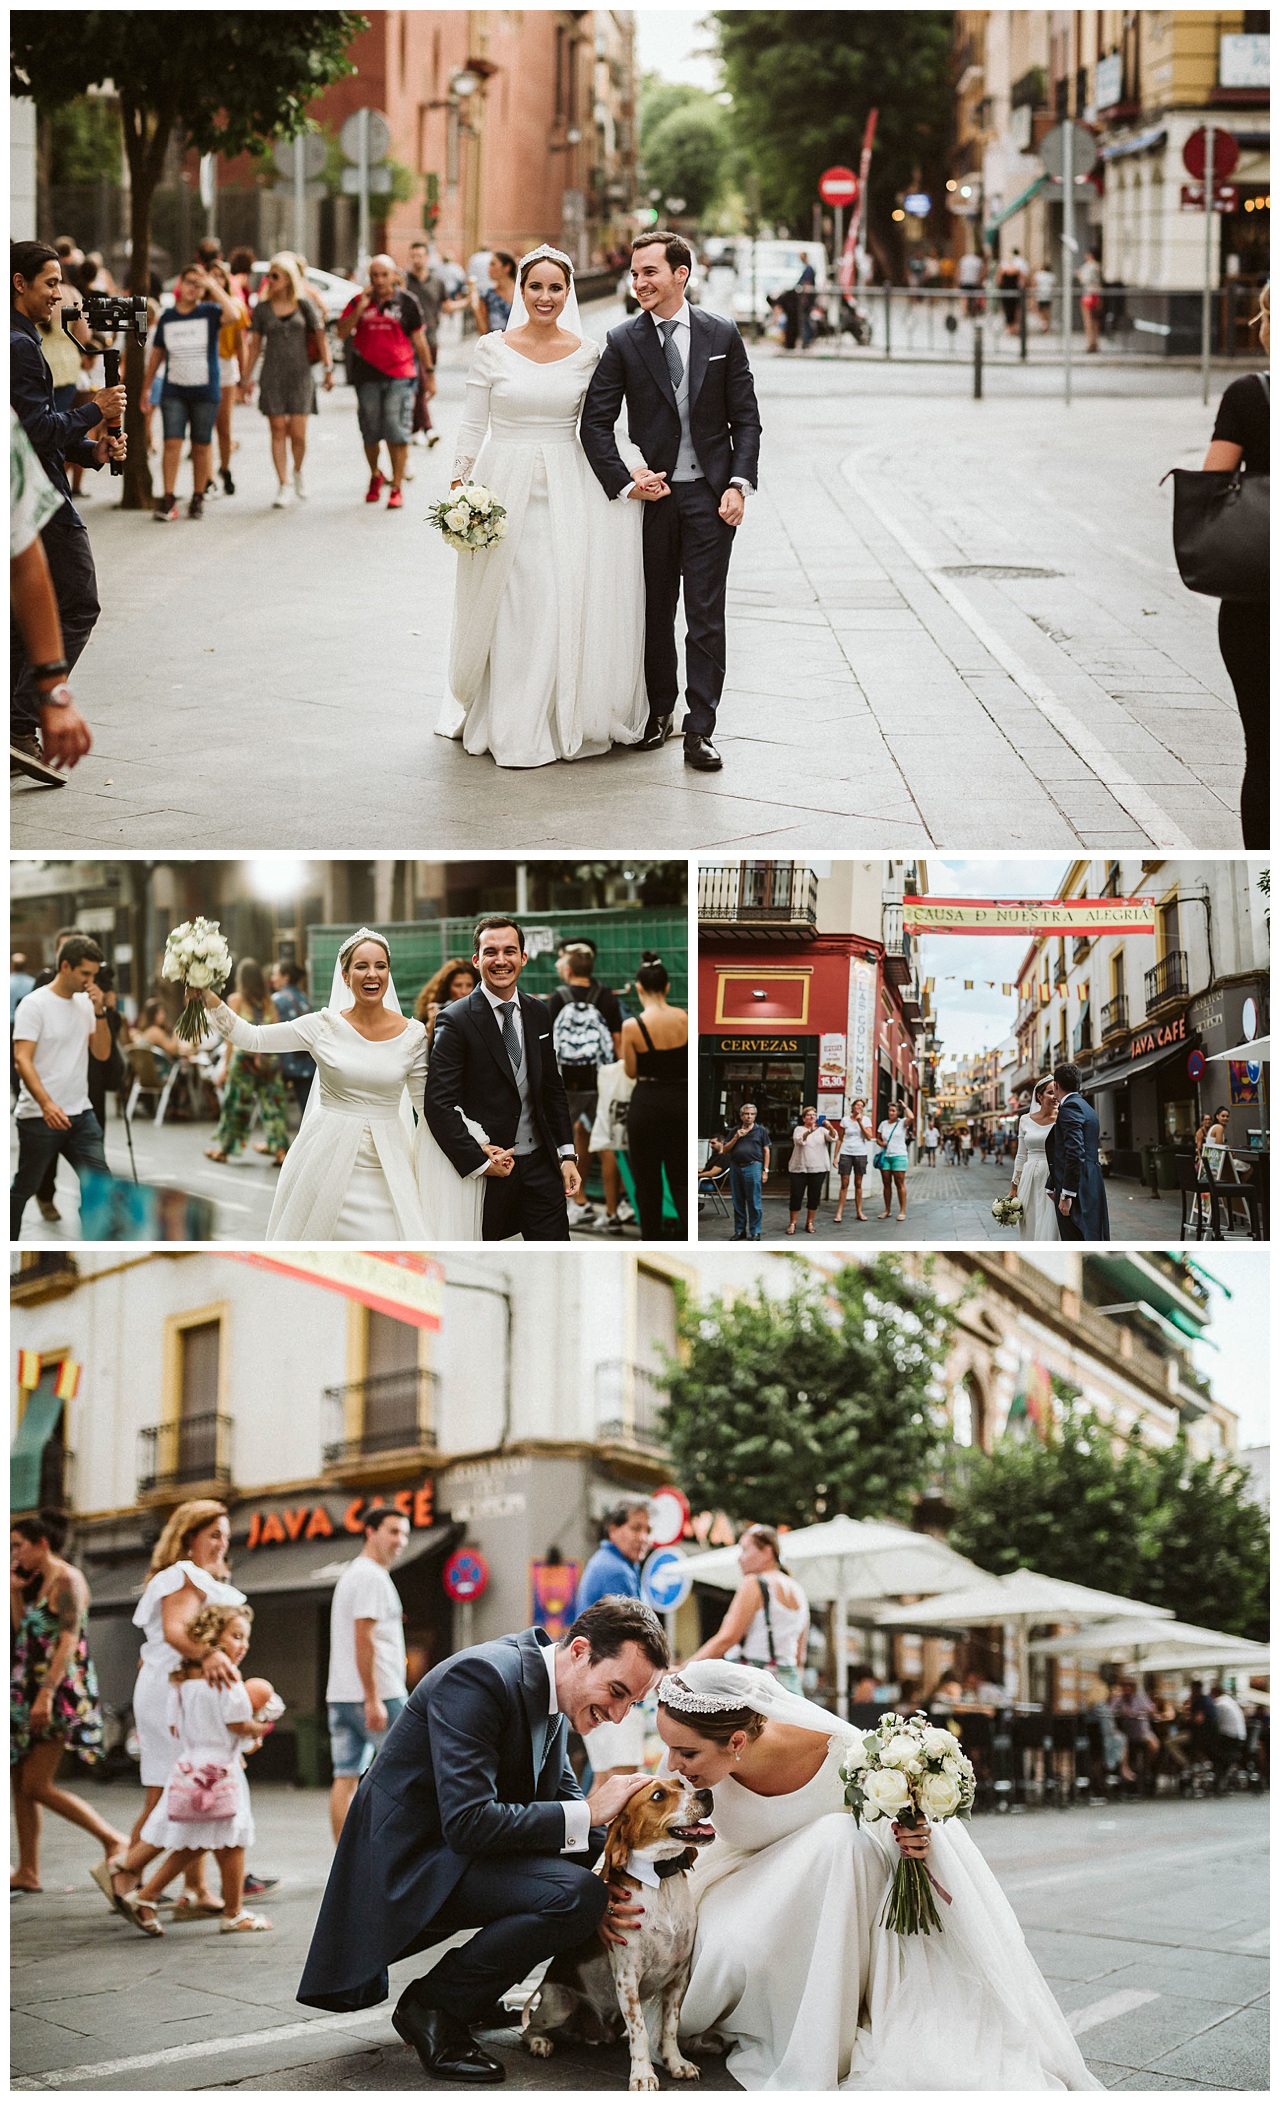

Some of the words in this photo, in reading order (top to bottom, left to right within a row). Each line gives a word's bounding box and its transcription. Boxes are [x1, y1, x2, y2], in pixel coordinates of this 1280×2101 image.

[914, 908, 964, 921] CAUSA
[997, 910, 1073, 923] NUESTRA
[721, 1039, 798, 1052] CERVEZAS
[854, 1015, 866, 1095] COLUMNAS
[1131, 1033, 1155, 1059] JAVA
[1157, 1013, 1186, 1046] CAFÉ
[247, 1505, 334, 1549] JAVA
